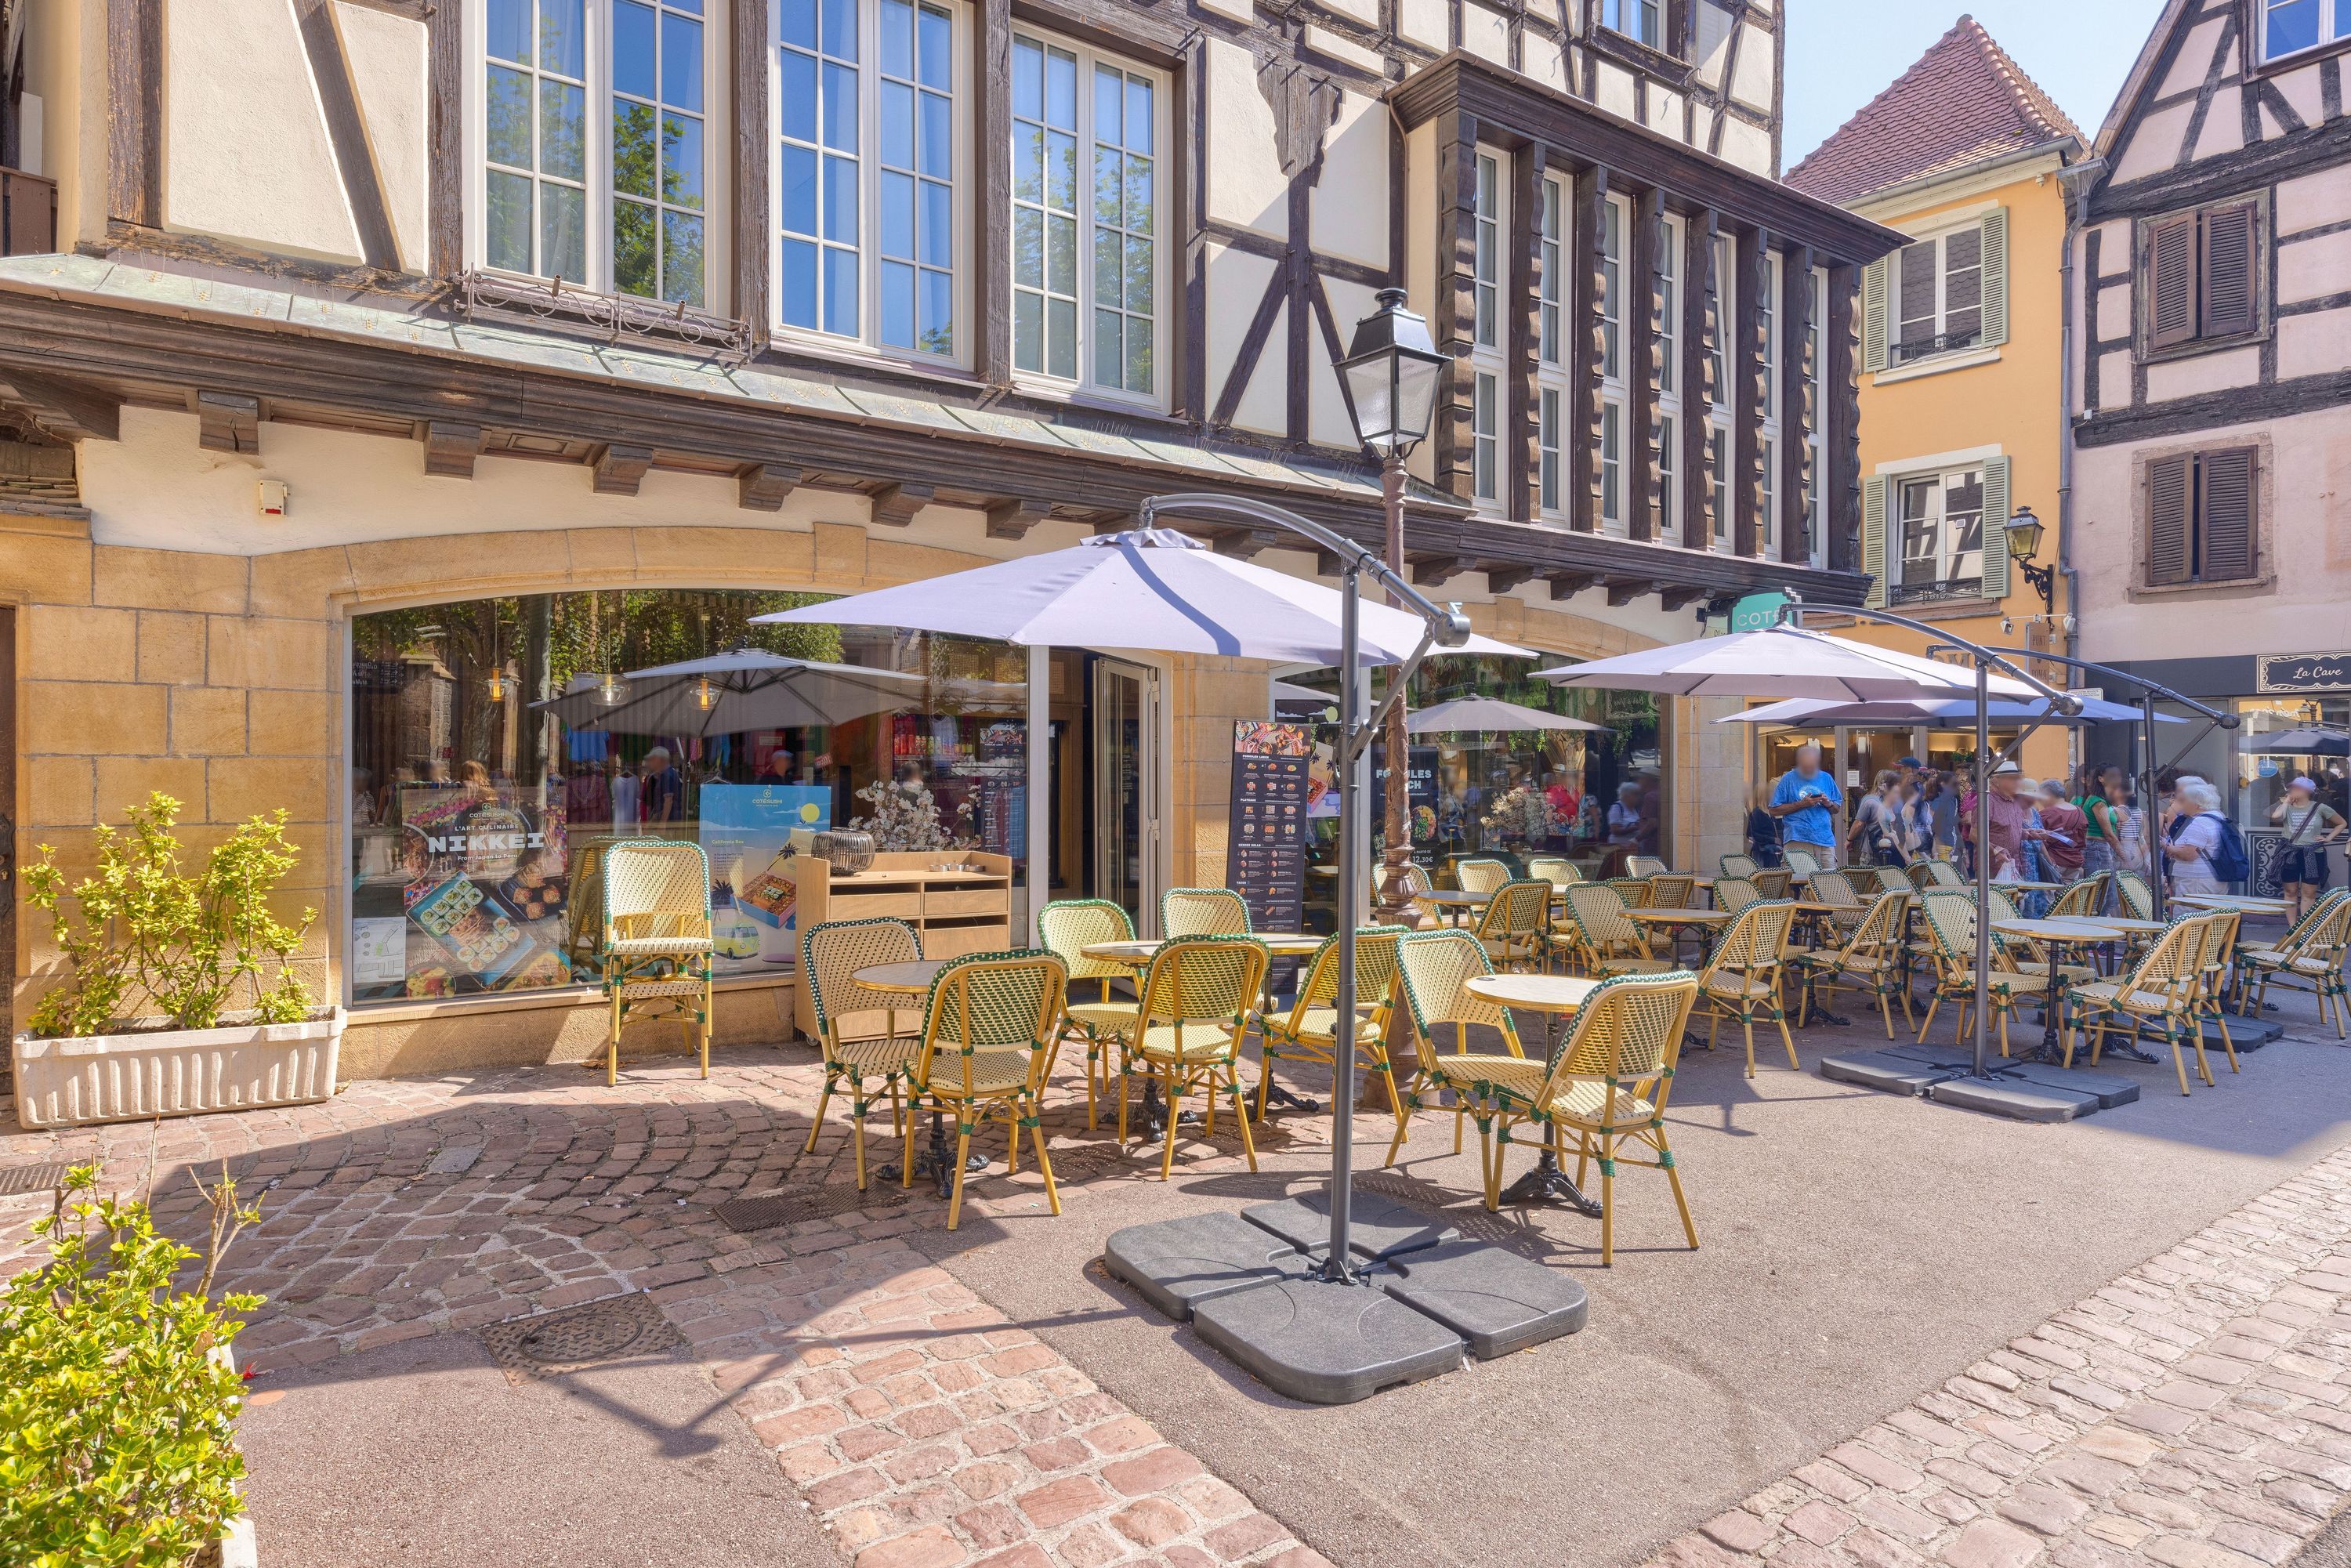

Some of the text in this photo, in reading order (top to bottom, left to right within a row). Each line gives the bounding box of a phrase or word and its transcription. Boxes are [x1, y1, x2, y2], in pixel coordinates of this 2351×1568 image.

[2031, 636, 2045, 646] PUNT
[2293, 666, 2343, 679] La Cave
[428, 832, 545, 853] NIKKEI
